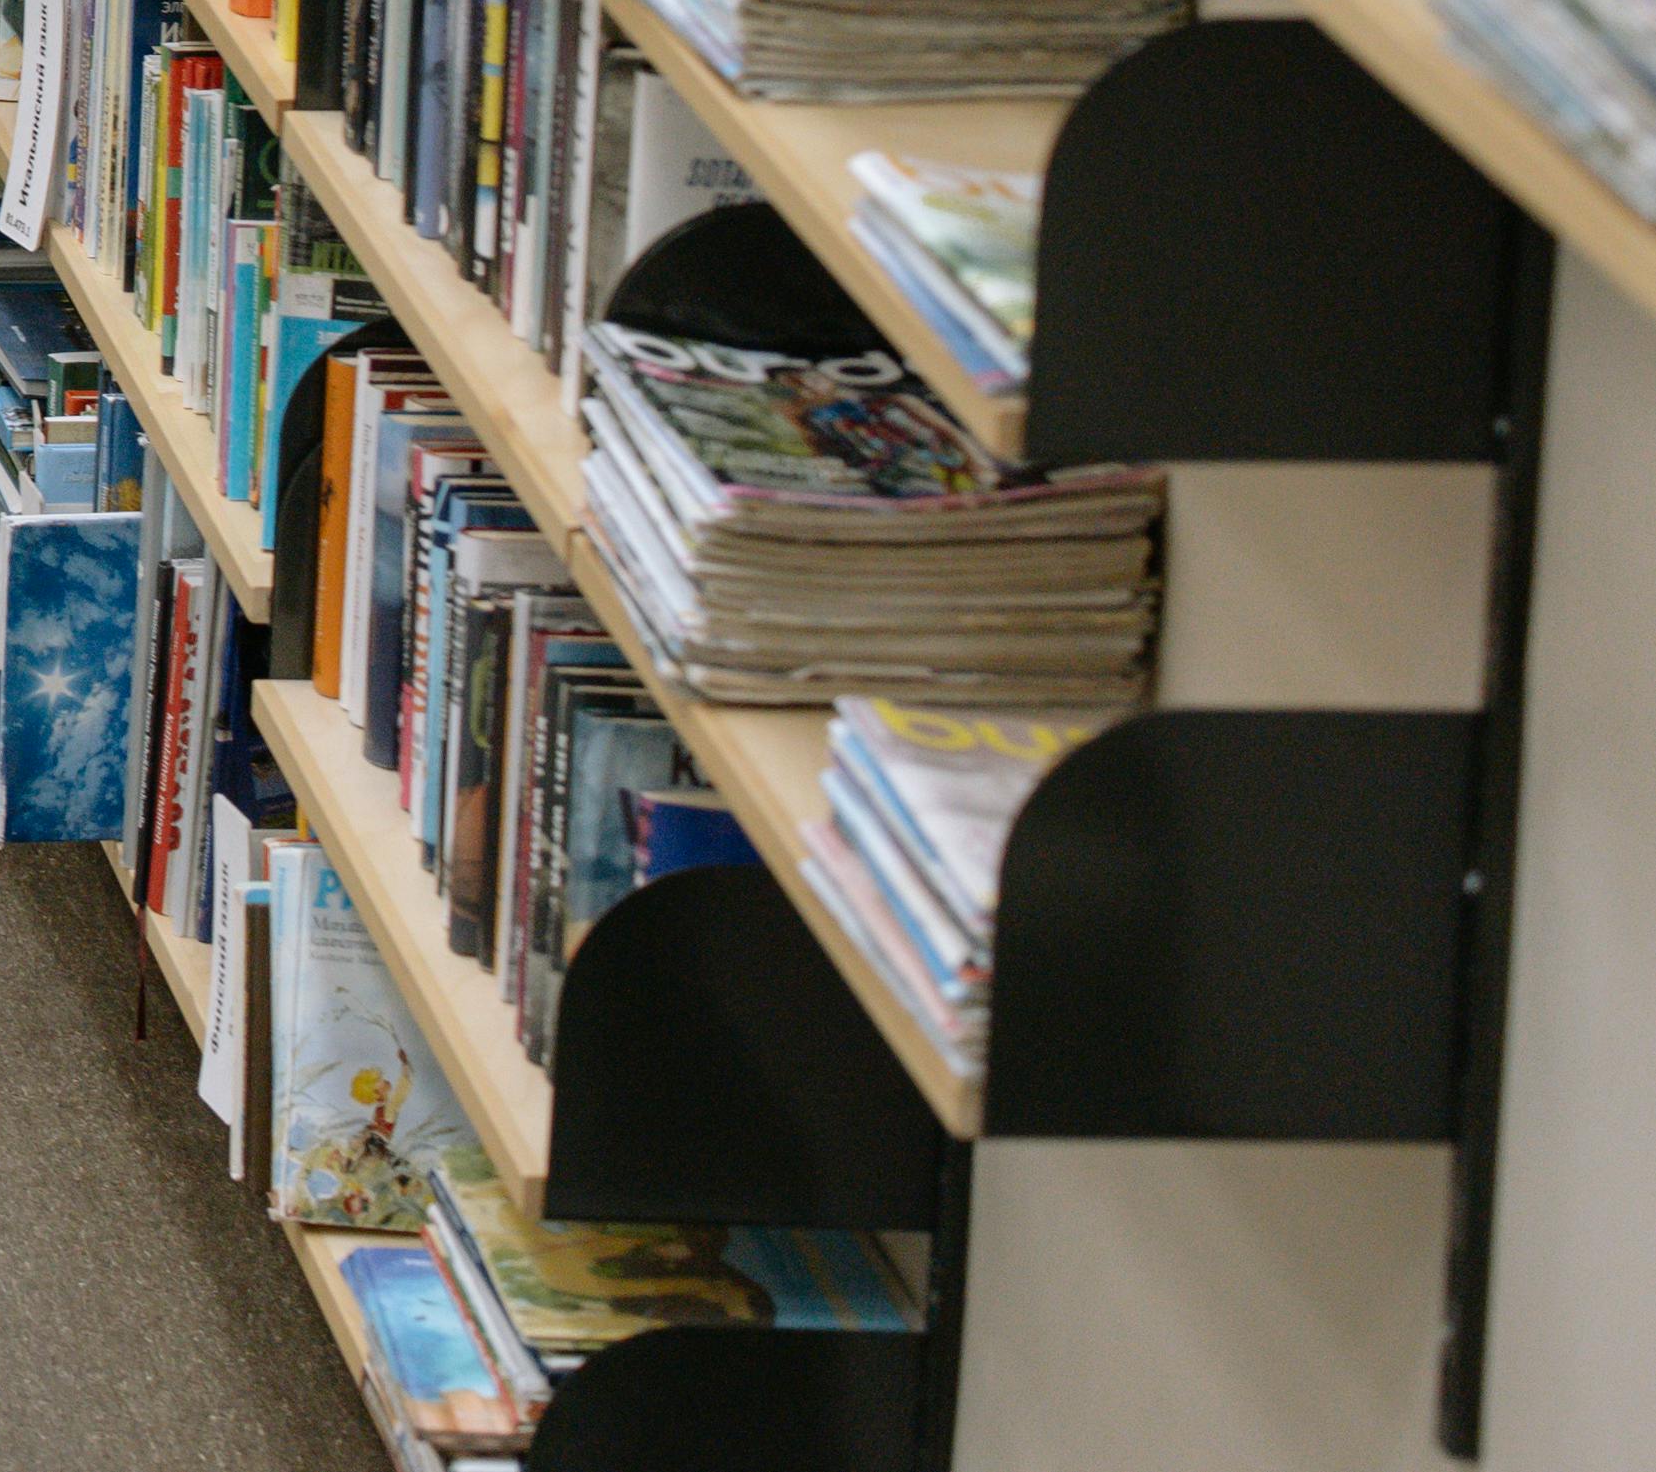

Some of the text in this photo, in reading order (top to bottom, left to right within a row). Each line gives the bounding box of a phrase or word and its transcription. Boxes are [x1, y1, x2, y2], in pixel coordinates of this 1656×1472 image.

[18, 3, 49, 207] Итальянский язык
[210, 934, 228, 1054] Финский
